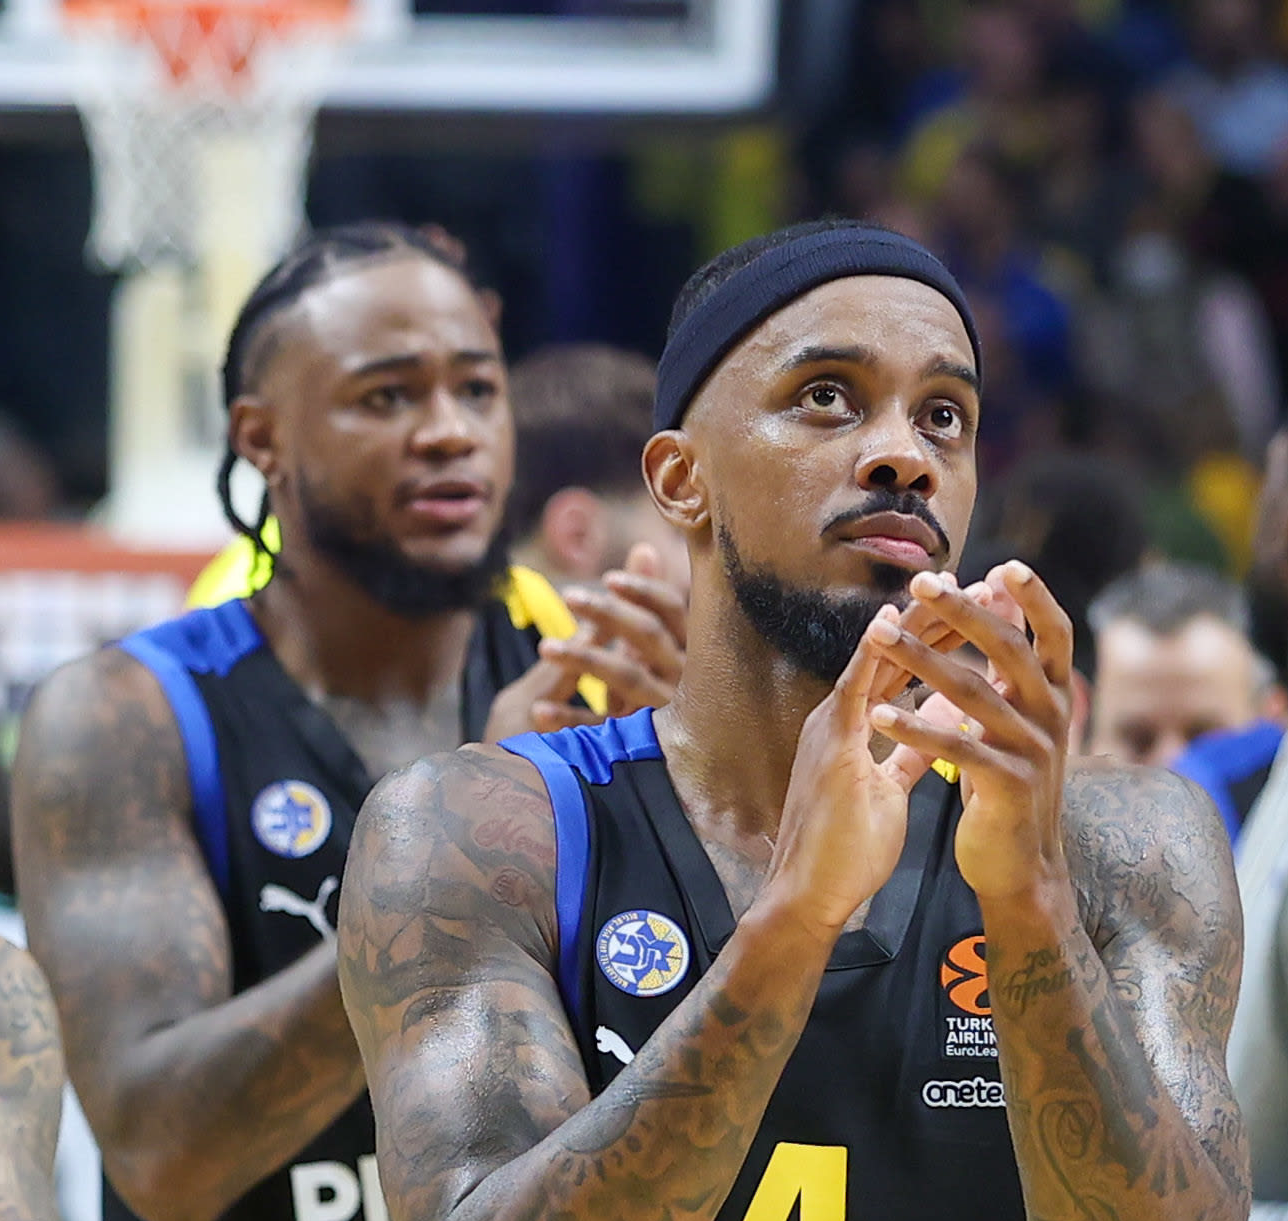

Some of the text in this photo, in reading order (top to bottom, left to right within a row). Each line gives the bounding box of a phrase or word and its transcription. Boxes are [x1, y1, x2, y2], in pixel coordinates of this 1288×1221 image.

[946, 1017, 994, 1031] TURK
[946, 1031, 998, 1045] AIRLIN
[946, 1045, 999, 1057] EuroLea
[924, 1078, 1006, 1105] onete
